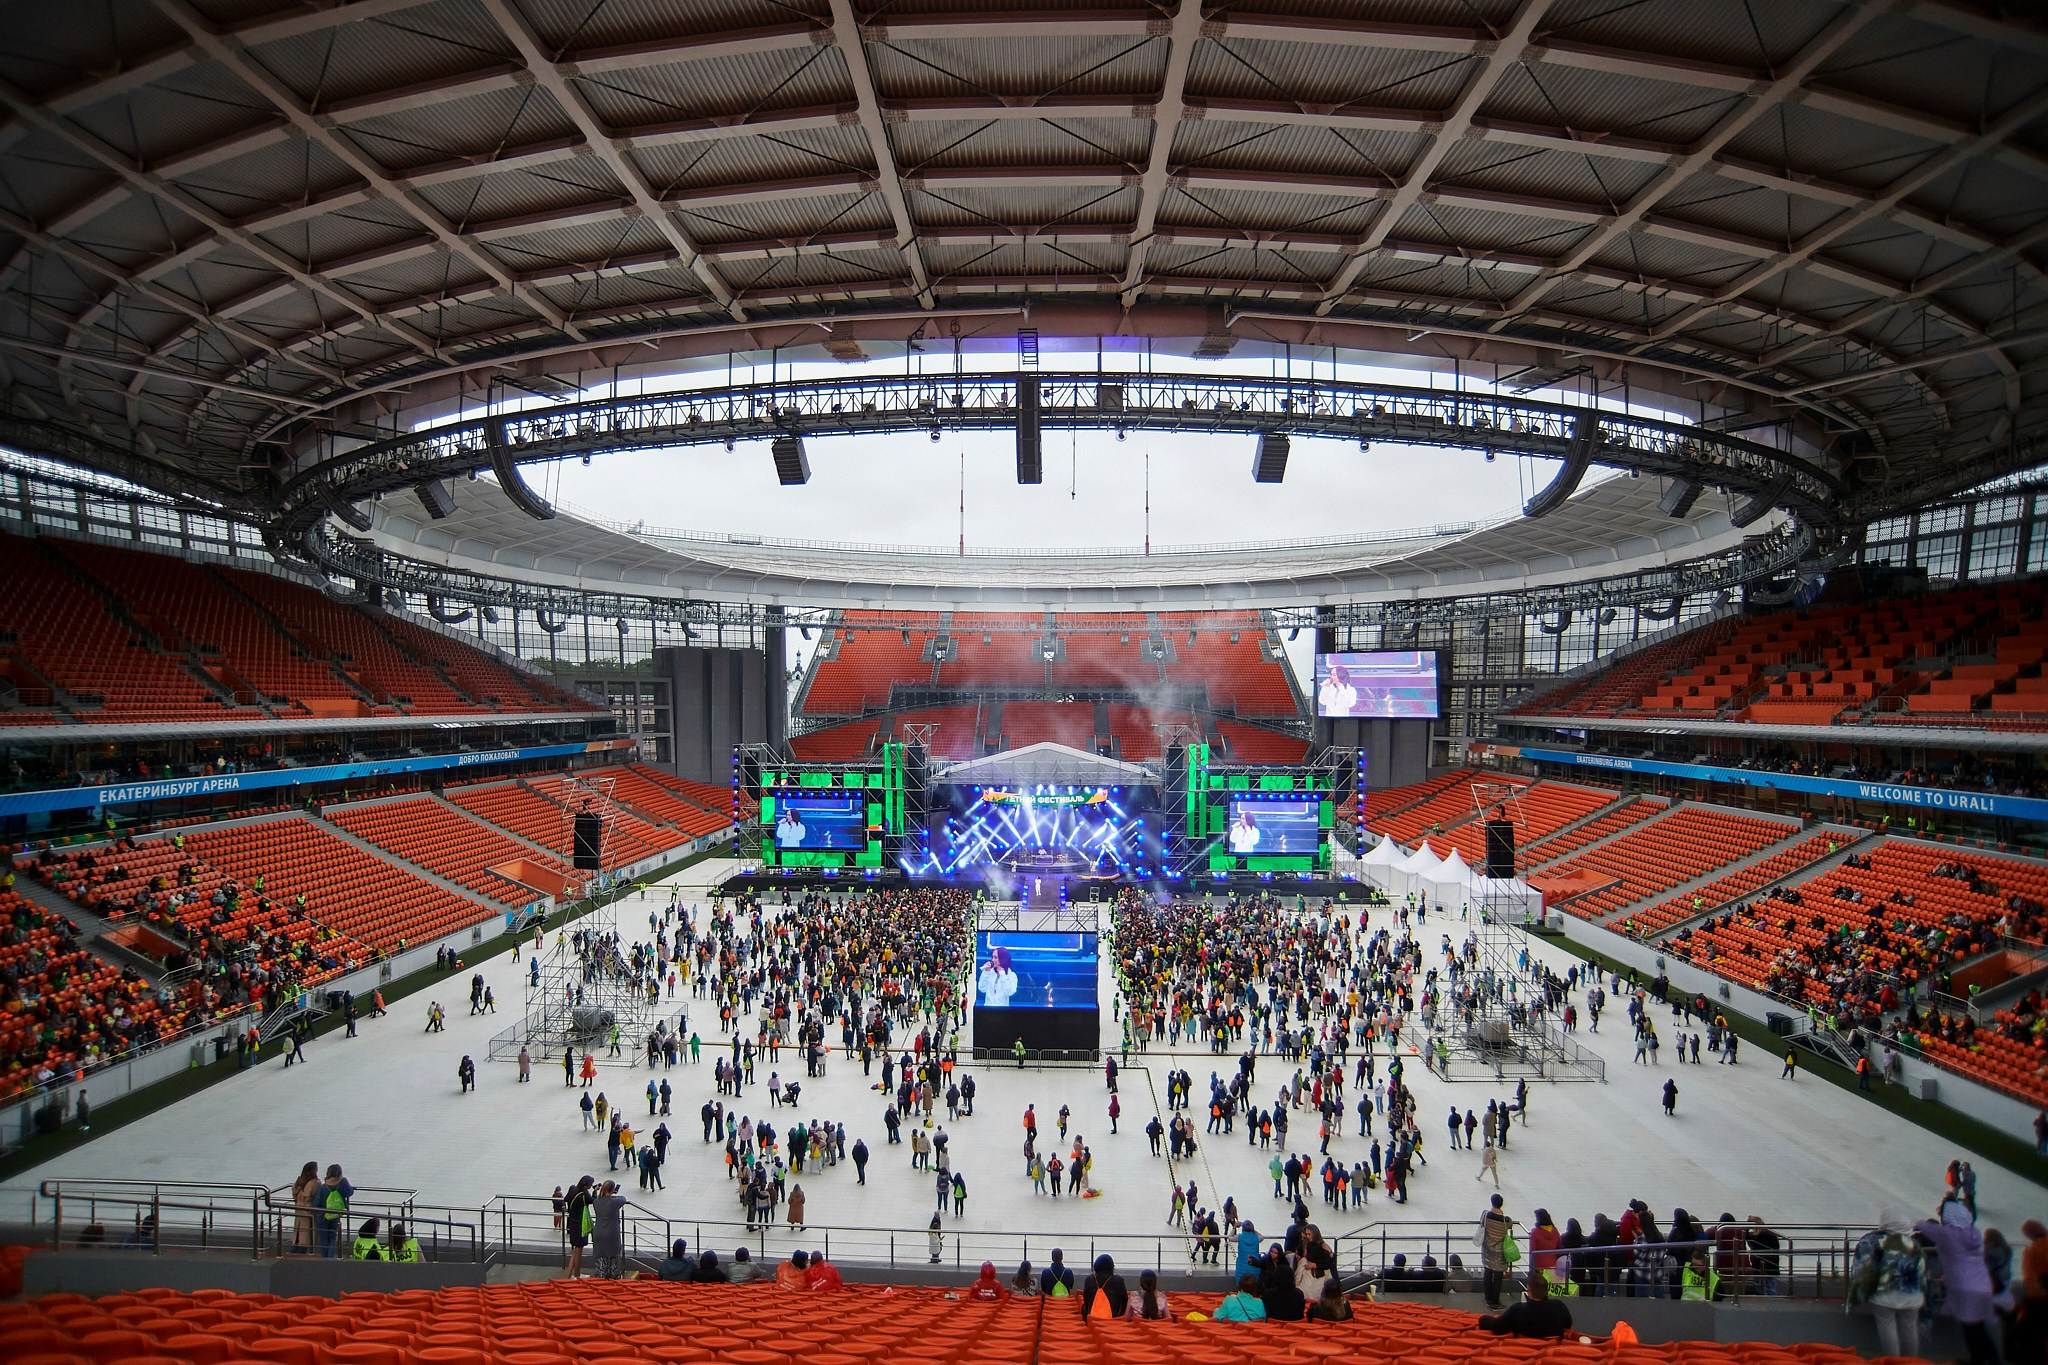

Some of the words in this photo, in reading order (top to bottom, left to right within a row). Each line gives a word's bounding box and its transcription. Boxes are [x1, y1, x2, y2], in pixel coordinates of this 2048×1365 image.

[459, 755, 480, 766] ДОБРО
[480, 750, 520, 762] ПОЖАЛОВАТЬ!
[1576, 755, 1613, 767] EKATERINBURG
[1613, 759, 1633, 769] ARENA
[99, 781, 200, 803] ЕКАТЕРИНБУРГ
[202, 777, 240, 792] АРЕНА
[1037, 796, 1085, 804] ФЕСТИВАЛЬ
[1860, 785, 1921, 803] WELCOME
[1925, 792, 1944, 806] TO
[1949, 794, 1994, 812] URAL!
